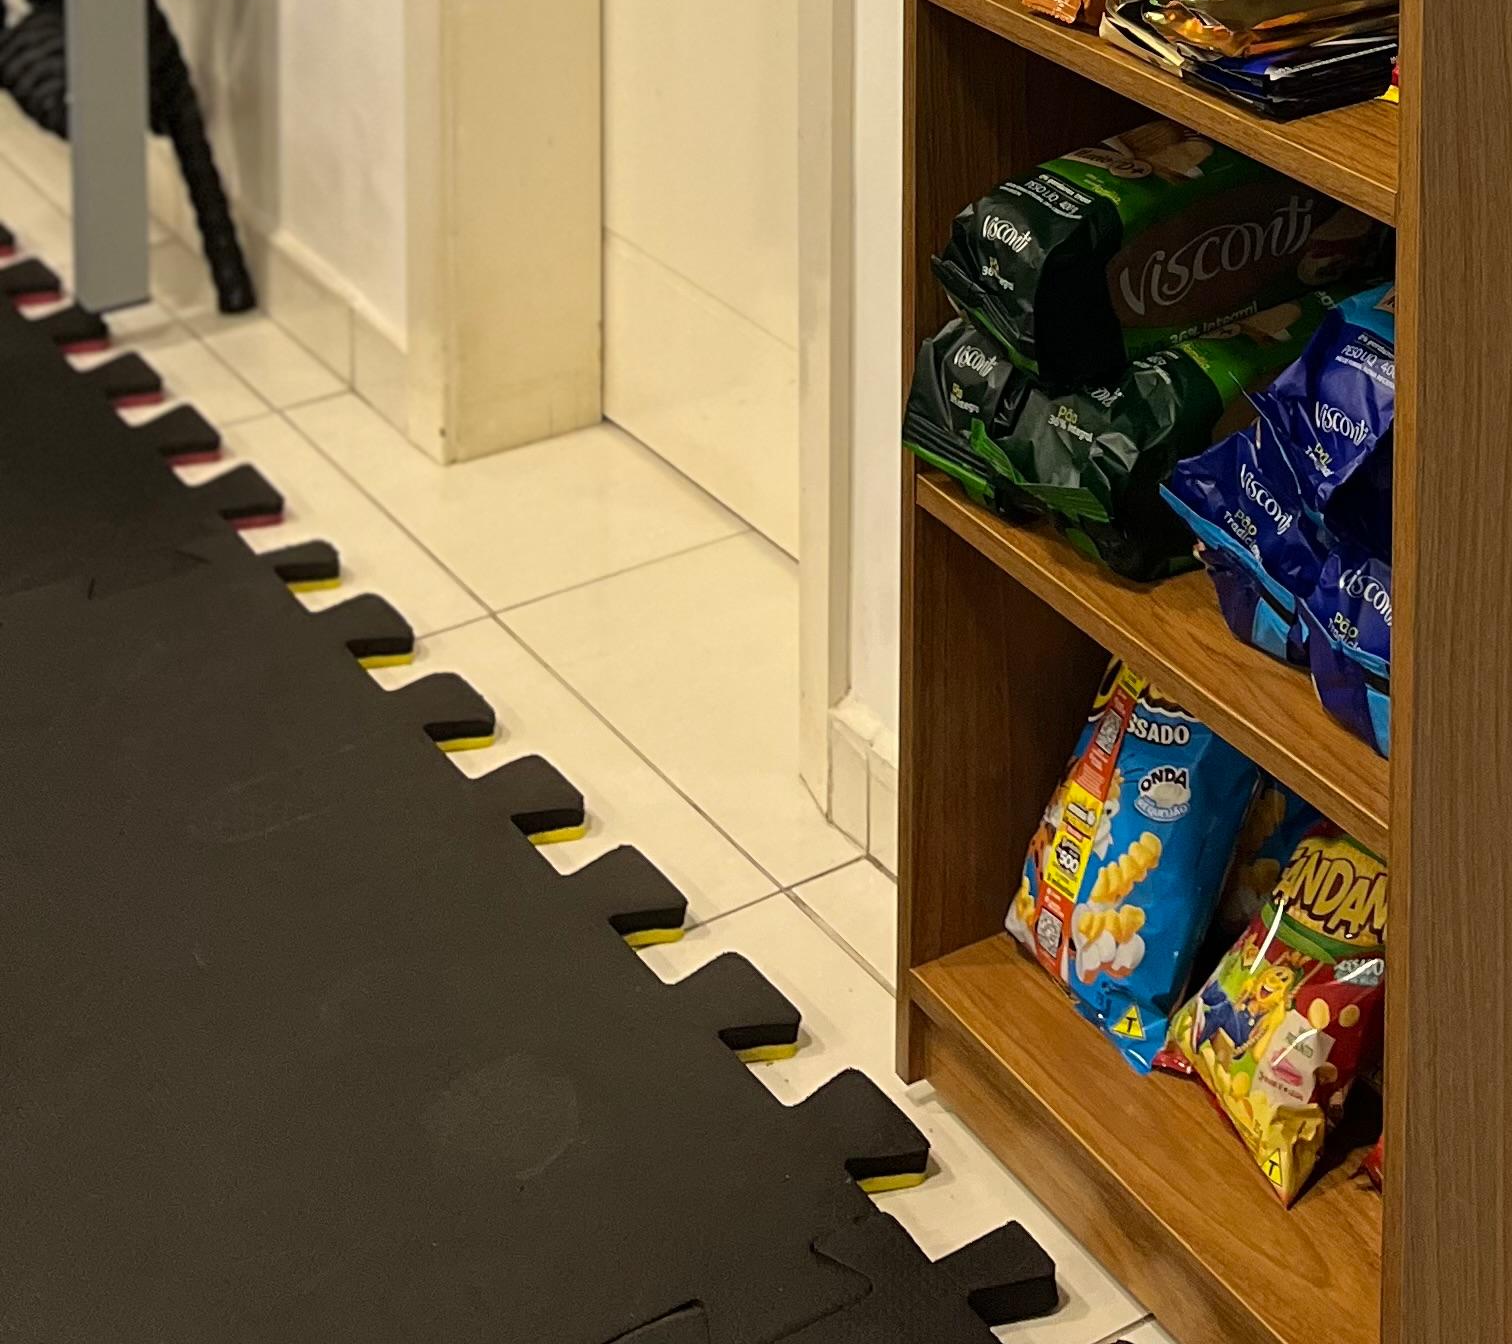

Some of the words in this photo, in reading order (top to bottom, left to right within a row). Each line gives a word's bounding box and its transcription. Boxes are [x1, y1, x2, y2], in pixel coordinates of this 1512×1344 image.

[982, 214, 1033, 254] Visconti
[1119, 194, 1315, 317] Visconti
[954, 344, 999, 378] Visconti
[1314, 400, 1369, 447] Visconti
[1234, 508, 1258, 536] Pão
[1333, 611, 1360, 639] Pão
[1140, 768, 1188, 792] ONDA
[1126, 1015, 1138, 1033] T
[1268, 1158, 1281, 1178] T
